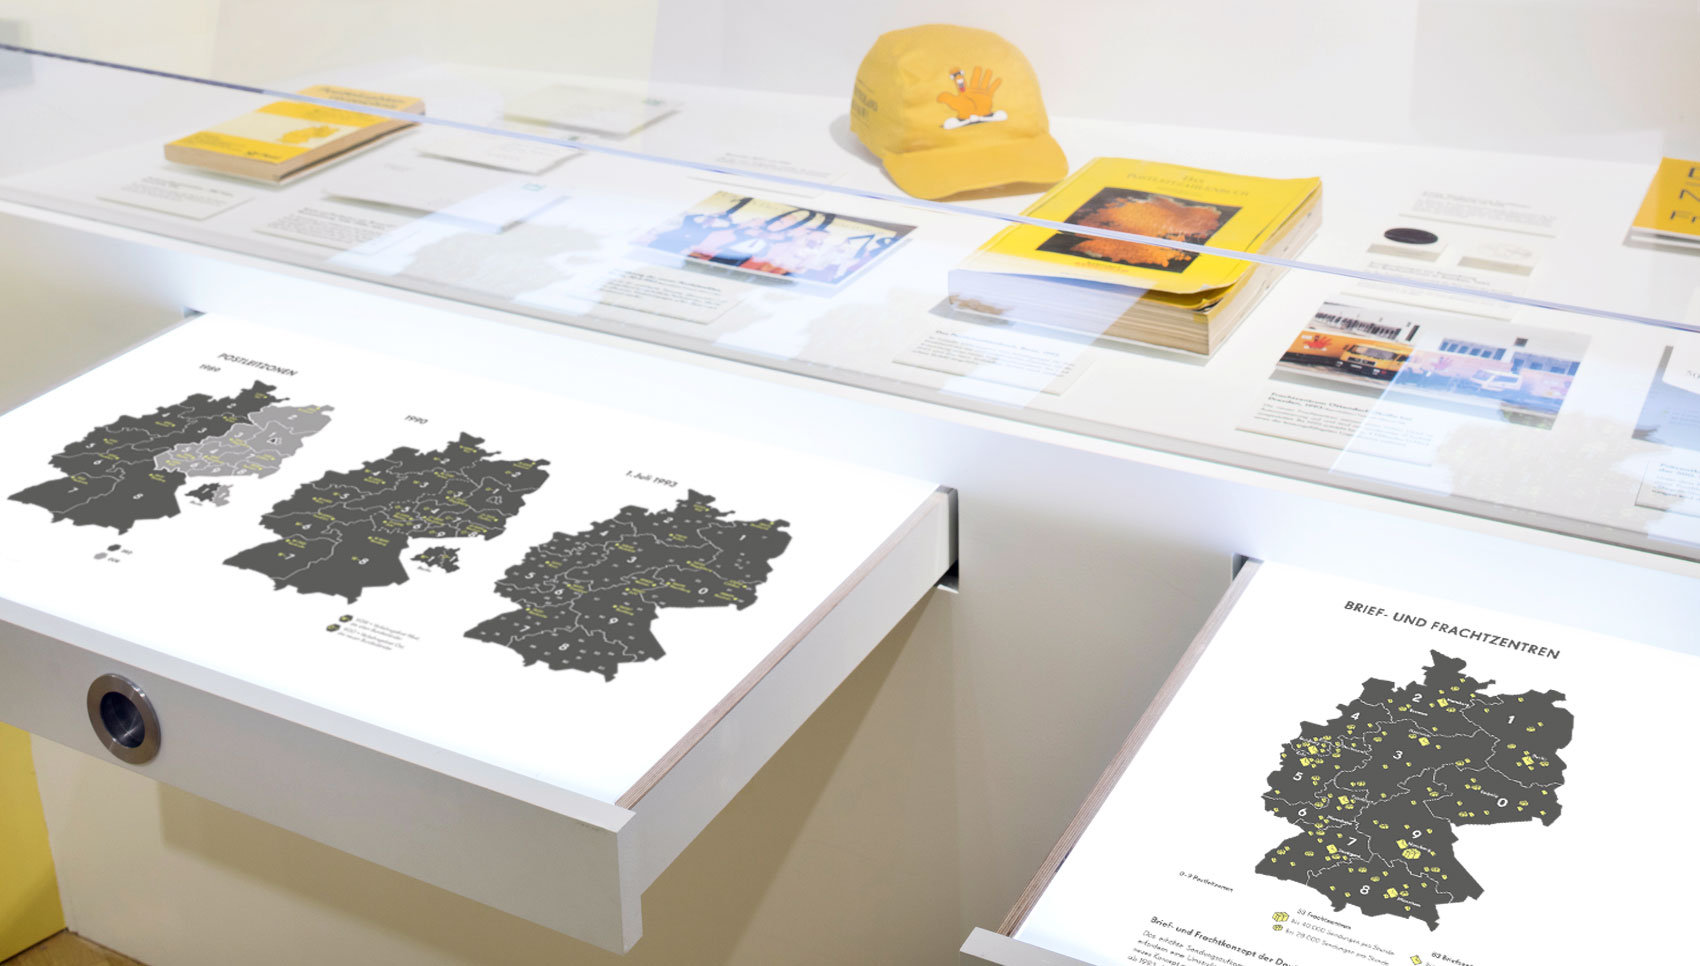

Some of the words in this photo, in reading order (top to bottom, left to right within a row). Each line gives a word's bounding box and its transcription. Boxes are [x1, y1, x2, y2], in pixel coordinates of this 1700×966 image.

[218, 353, 298, 376] POSTLEITZONEN
[633, 472, 652, 482] Juli
[653, 476, 679, 488] 1993
[1344, 601, 1387, 616] BRIEF-
[1393, 612, 1427, 627] UND
[1430, 621, 1561, 660] FRACHTZENTREN
[1412, 694, 1422, 702] 2
[1393, 751, 1402, 759] 3
[1293, 772, 1303, 780] 5
[1497, 798, 1508, 807] 0
[1298, 808, 1306, 816] 6
[1413, 830, 1421, 838] 9
[1347, 837, 1357, 845] 7
[1360, 885, 1370, 894] 8
[1150, 915, 1175, 929] Brief-
[1175, 926, 1194, 936] und
[1194, 930, 1257, 957] Frachtkonzept
[1258, 953, 1274, 963] der
